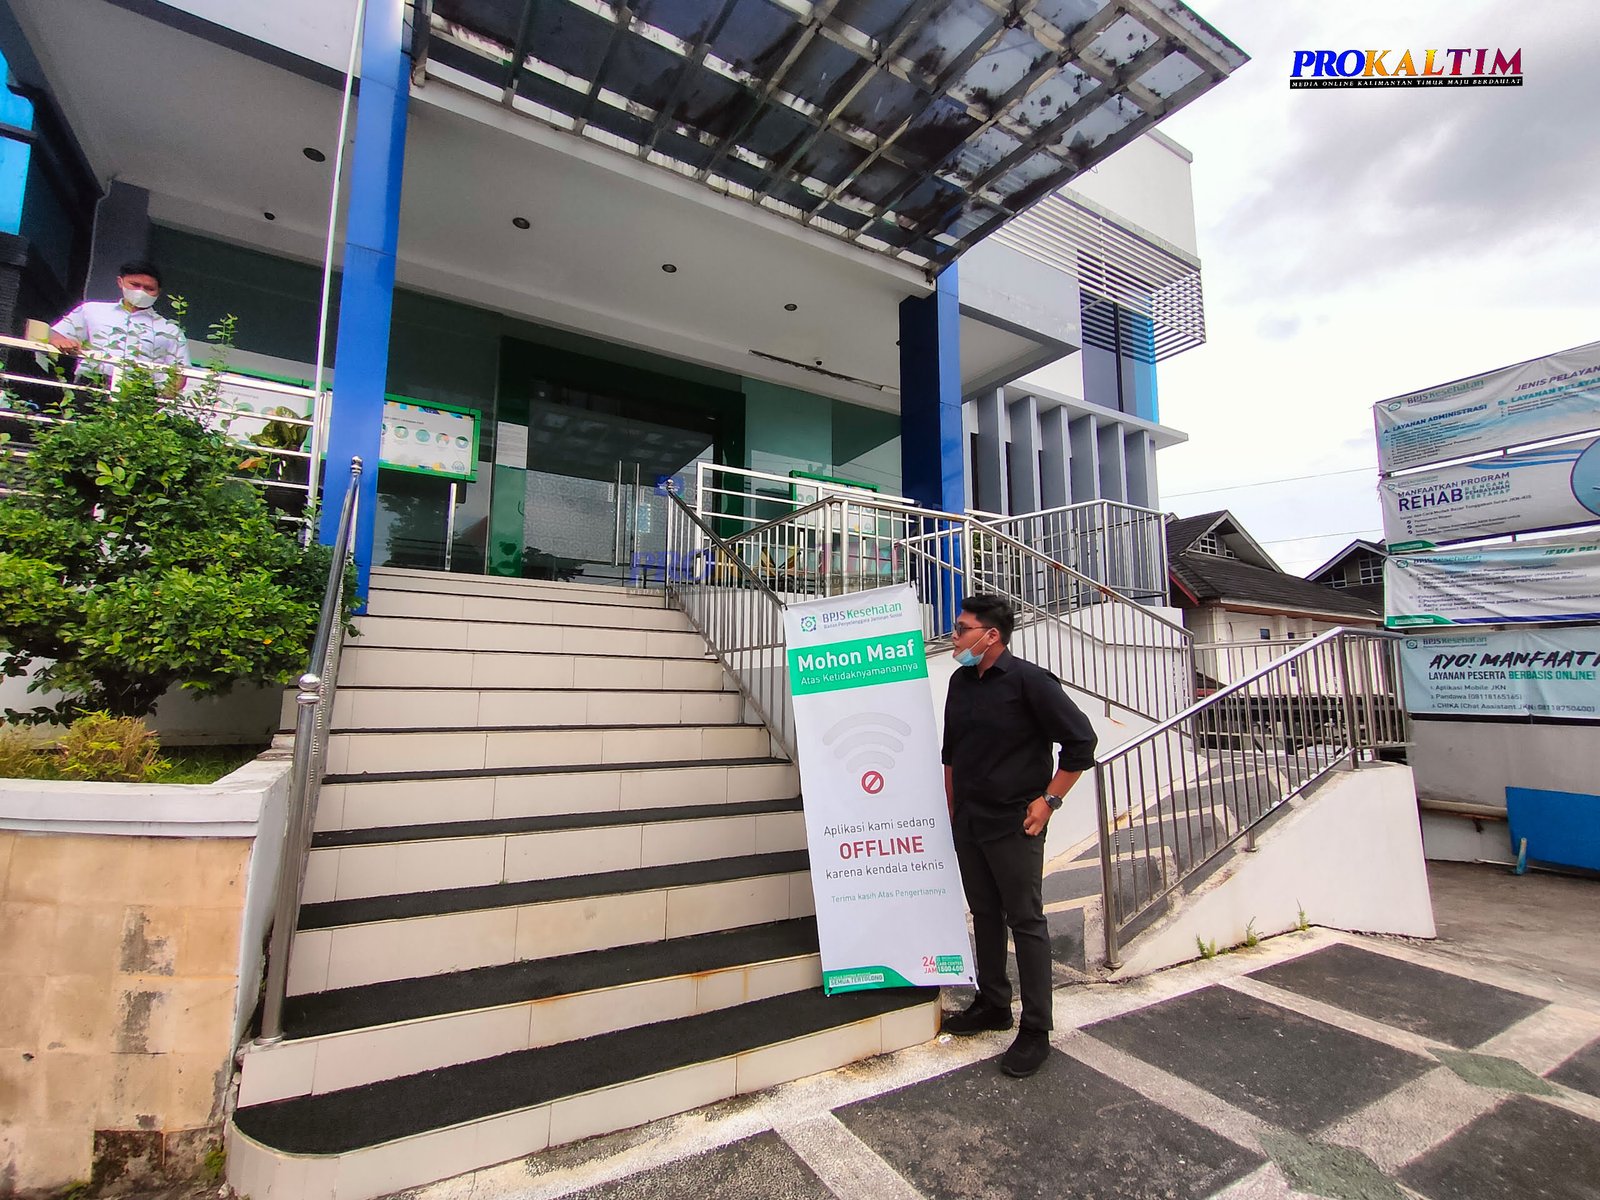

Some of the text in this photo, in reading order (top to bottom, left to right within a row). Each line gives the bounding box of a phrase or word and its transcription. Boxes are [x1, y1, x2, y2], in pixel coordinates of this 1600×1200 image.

[1407, 393, 1428, 405] BPJS
[1429, 380, 1485, 399] Kesehatan
[1511, 387, 1556, 403] LAYANAN
[1515, 378, 1547, 391] JENIS
[1393, 418, 1427, 432] LAYANAN
[1427, 404, 1488, 423] ADMINISTRASI
[1397, 472, 1510, 498] MANFAATKAN PROGRAM
[1464, 484, 1510, 496] PEMBAYARAN
[1399, 488, 1464, 512] REHAB
[822, 602, 902, 623] BPJS Kesehatan
[797, 639, 915, 672] Mohon Maaf
[1429, 653, 1477, 670] AYO!
[800, 662, 919, 686] Atas Ketidaknyamanannya
[1428, 670, 1596, 680] LAYANAN PESERTA BERBASIS ONLINE!
[824, 817, 935, 838] Aplikasi kami sedang
[839, 836, 924, 860] OFFLINE
[825, 859, 945, 880] karena kendala teknis
[831, 887, 946, 904] Terima kasih Atas Pengertiannya
[922, 956, 936, 967] 24
